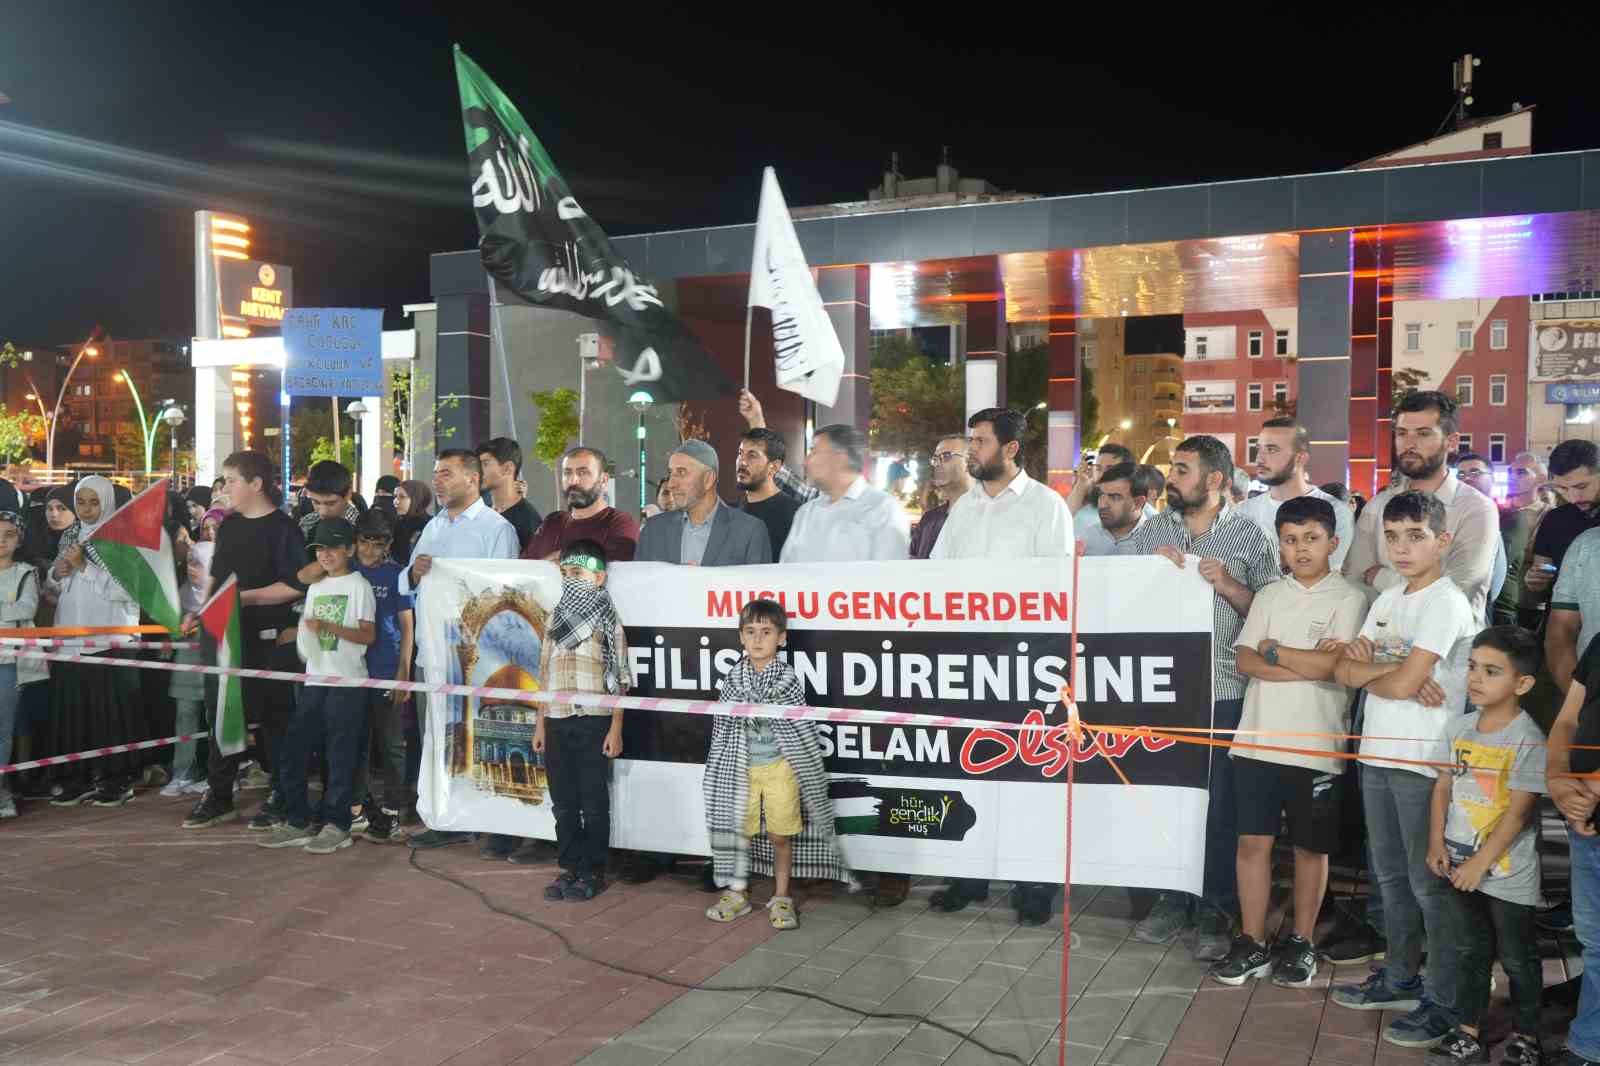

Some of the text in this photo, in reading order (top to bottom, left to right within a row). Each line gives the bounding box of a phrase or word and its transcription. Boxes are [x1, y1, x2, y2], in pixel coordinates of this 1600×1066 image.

[251, 287, 282, 304] KENT
[240, 301, 284, 321] MEYDA
[707, 590, 1068, 628] MULU GENÇLERDEN
[628, 634, 1176, 714] FİLİSN DİRENİŞİNE
[816, 724, 951, 763] SELAM
[900, 795, 923, 808] hür
[889, 806, 940, 824] gençlik
[908, 824, 928, 836] MUŞ
